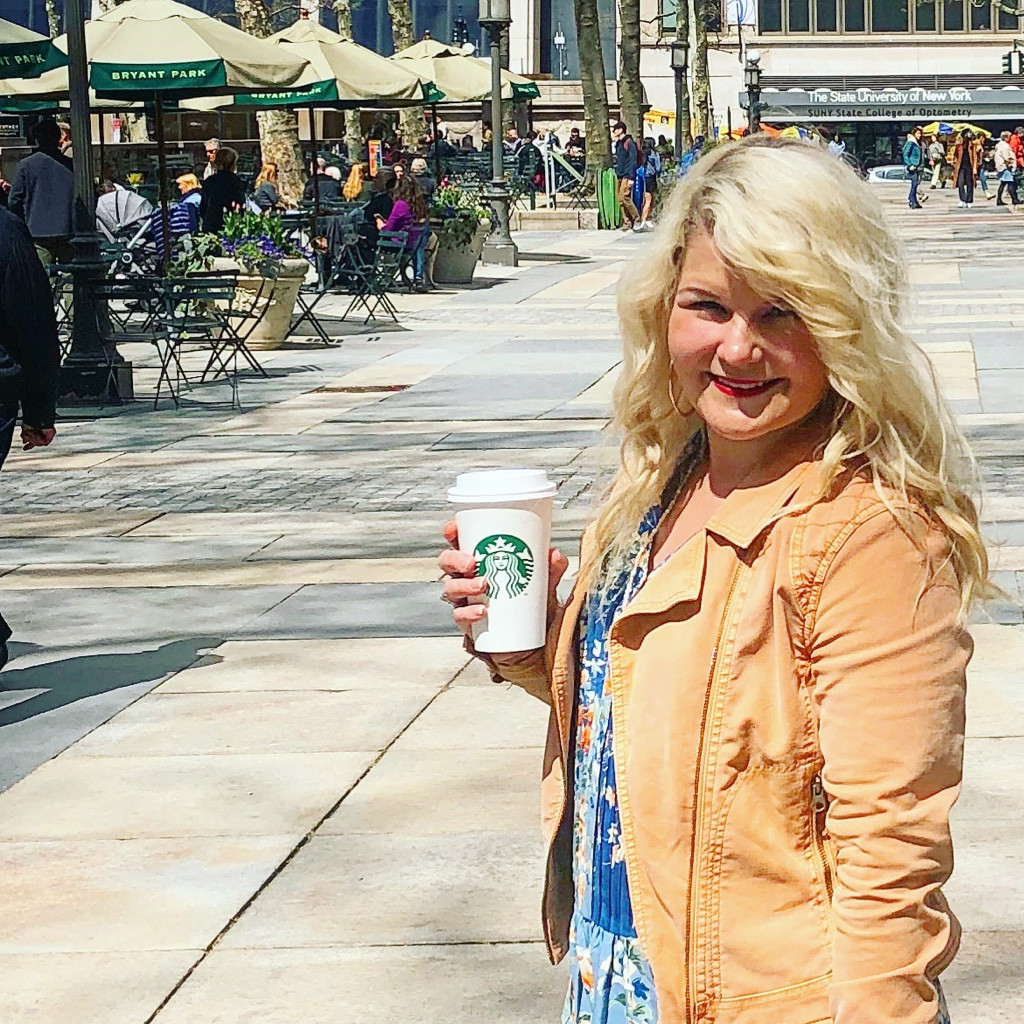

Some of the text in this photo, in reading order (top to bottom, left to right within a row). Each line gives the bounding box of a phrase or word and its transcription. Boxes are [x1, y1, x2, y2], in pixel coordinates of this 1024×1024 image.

[14, 54, 46, 64] PARK
[111, 69, 207, 80] BRYANT PARK
[807, 90, 973, 105] The State University of New York
[808, 108, 972, 118] SUNY State College of Optometry
